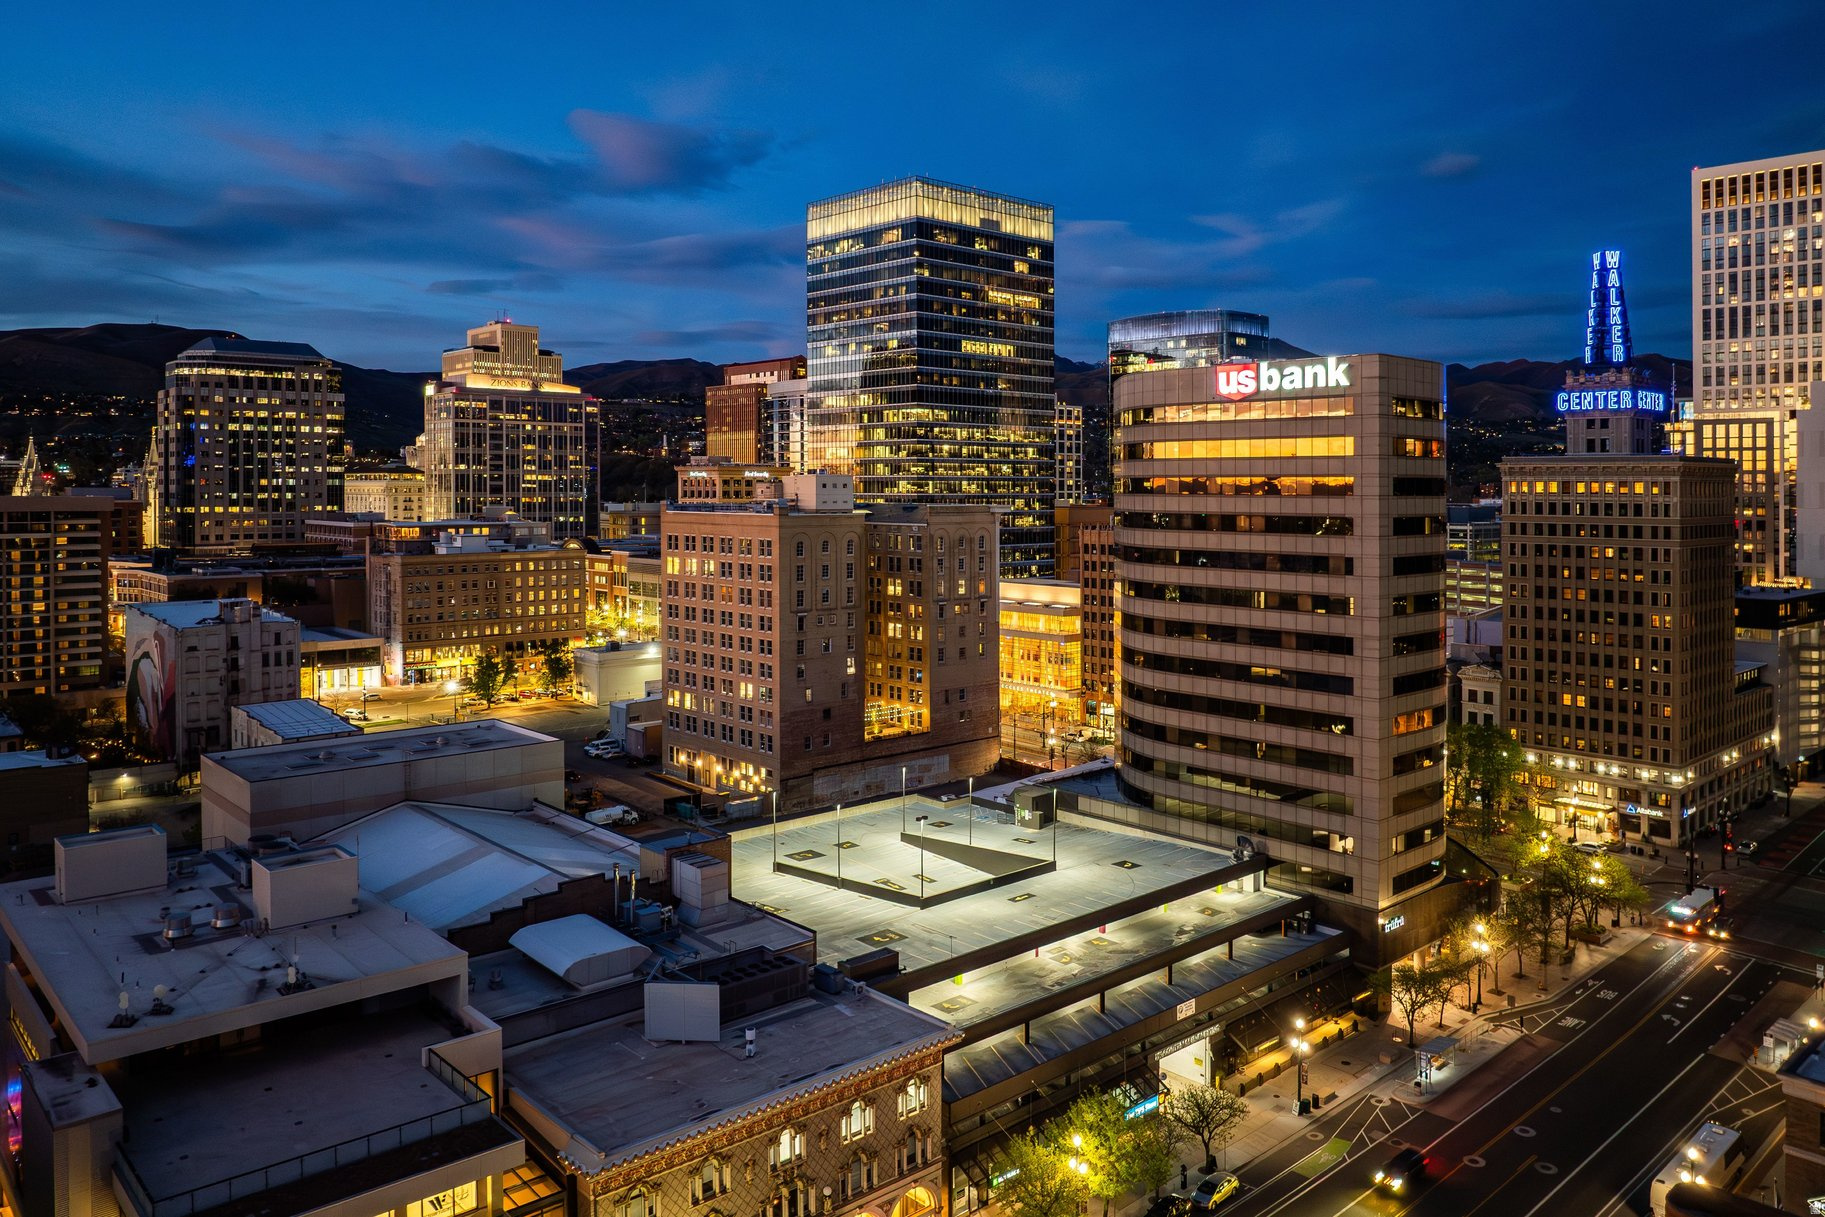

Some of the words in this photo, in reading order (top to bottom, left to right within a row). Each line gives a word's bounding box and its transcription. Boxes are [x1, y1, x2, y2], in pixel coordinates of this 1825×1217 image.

[1585, 252, 1600, 364] WALKER
[1605, 251, 1624, 362] WALKER
[491, 379, 518, 388] ZIONS
[521, 381, 545, 390] BANK
[1557, 390, 1632, 411] CENTER
[1638, 391, 1664, 412] CENTER
[1636, 807, 1663, 818] Altabank
